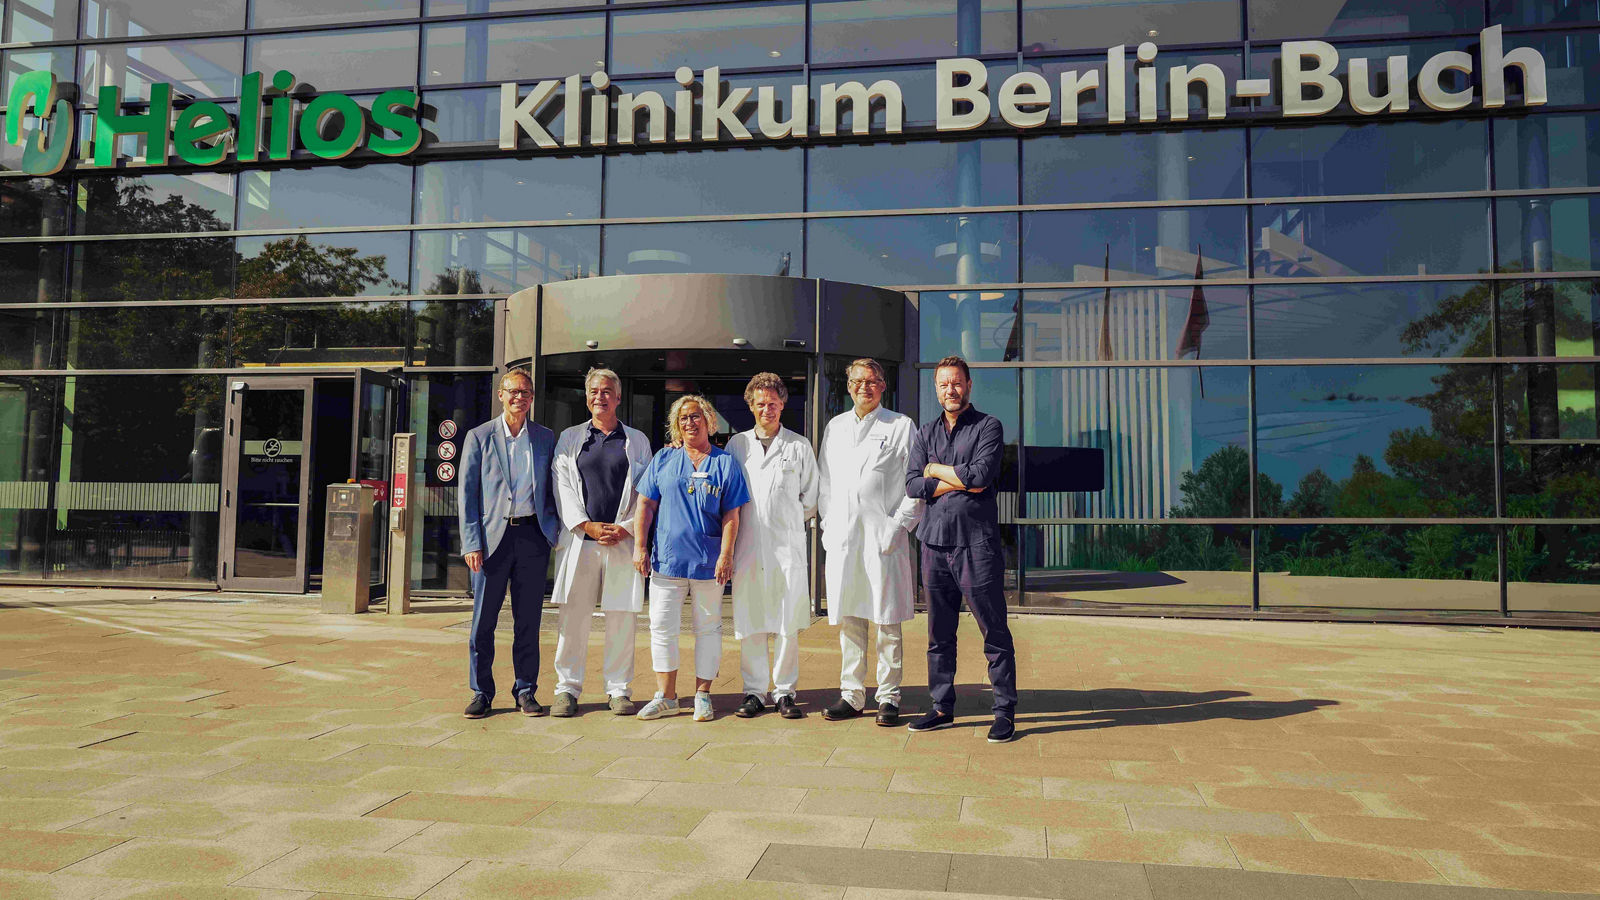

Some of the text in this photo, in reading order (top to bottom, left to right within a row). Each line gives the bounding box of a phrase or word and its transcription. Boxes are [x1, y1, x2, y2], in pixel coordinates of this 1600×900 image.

[94, 24, 1548, 168] Helios Klinikum Berlin-Buch
